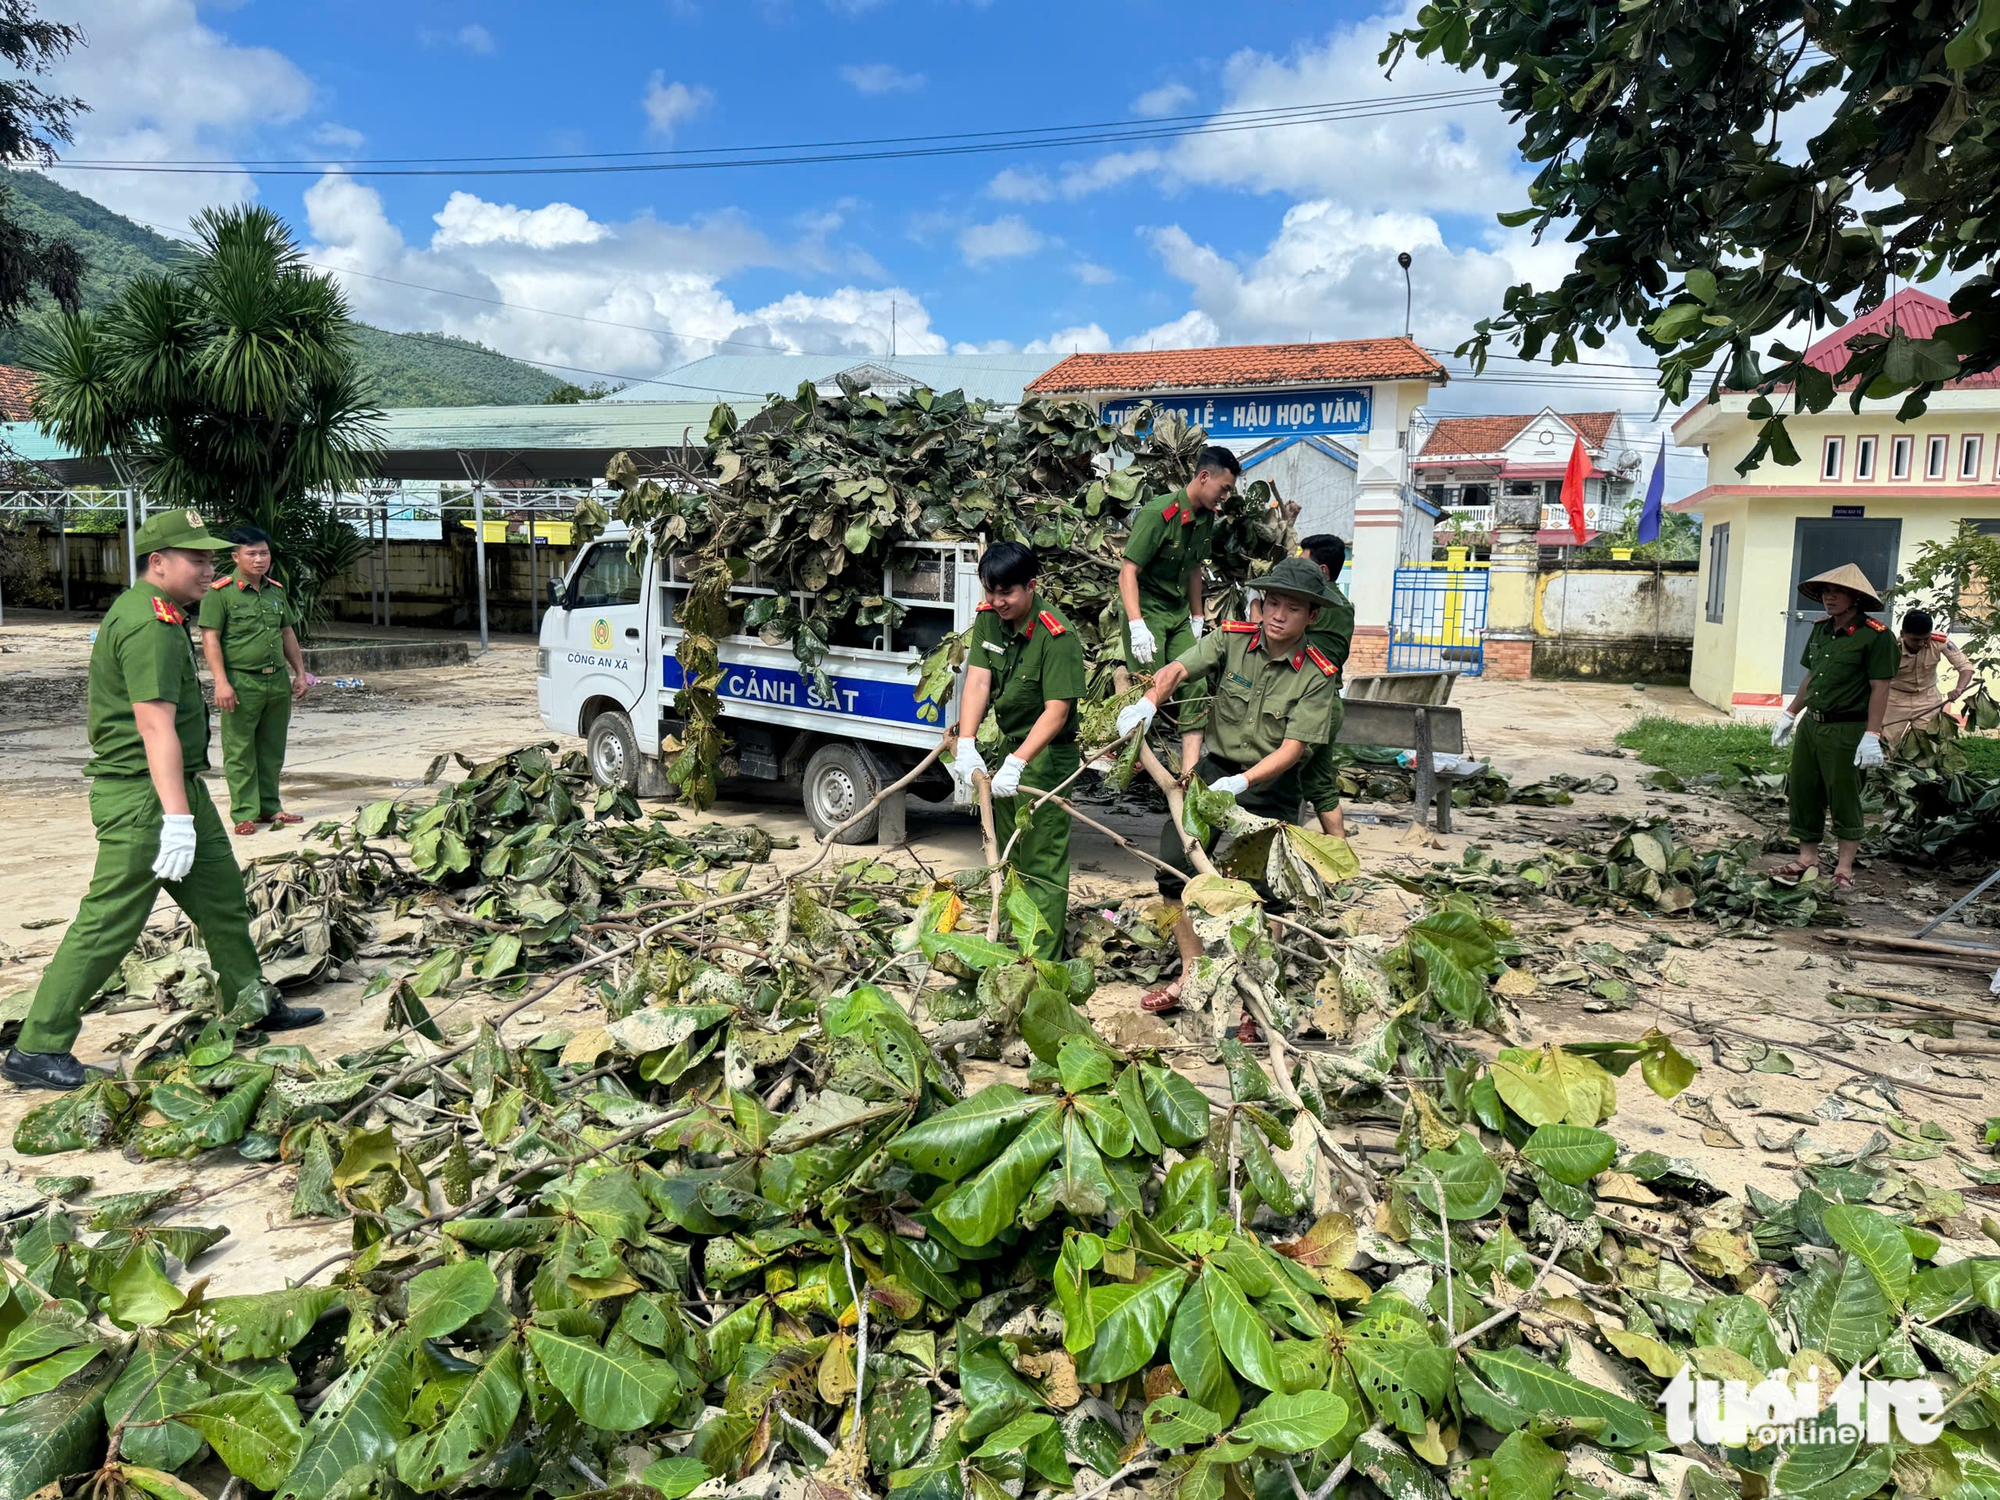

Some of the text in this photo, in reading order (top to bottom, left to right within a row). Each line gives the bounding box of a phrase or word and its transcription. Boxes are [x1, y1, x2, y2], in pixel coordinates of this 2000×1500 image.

[1109, 405, 1138, 427] TIÊ
[1194, 399, 1215, 428] LỄ
[1232, 403, 1271, 432] HẬU
[1276, 403, 1316, 430] HỌC
[1321, 397, 1362, 424] VĂN
[567, 651, 629, 671] CÔNG AN XÃ
[728, 668, 860, 713] CẢNH SÁT
